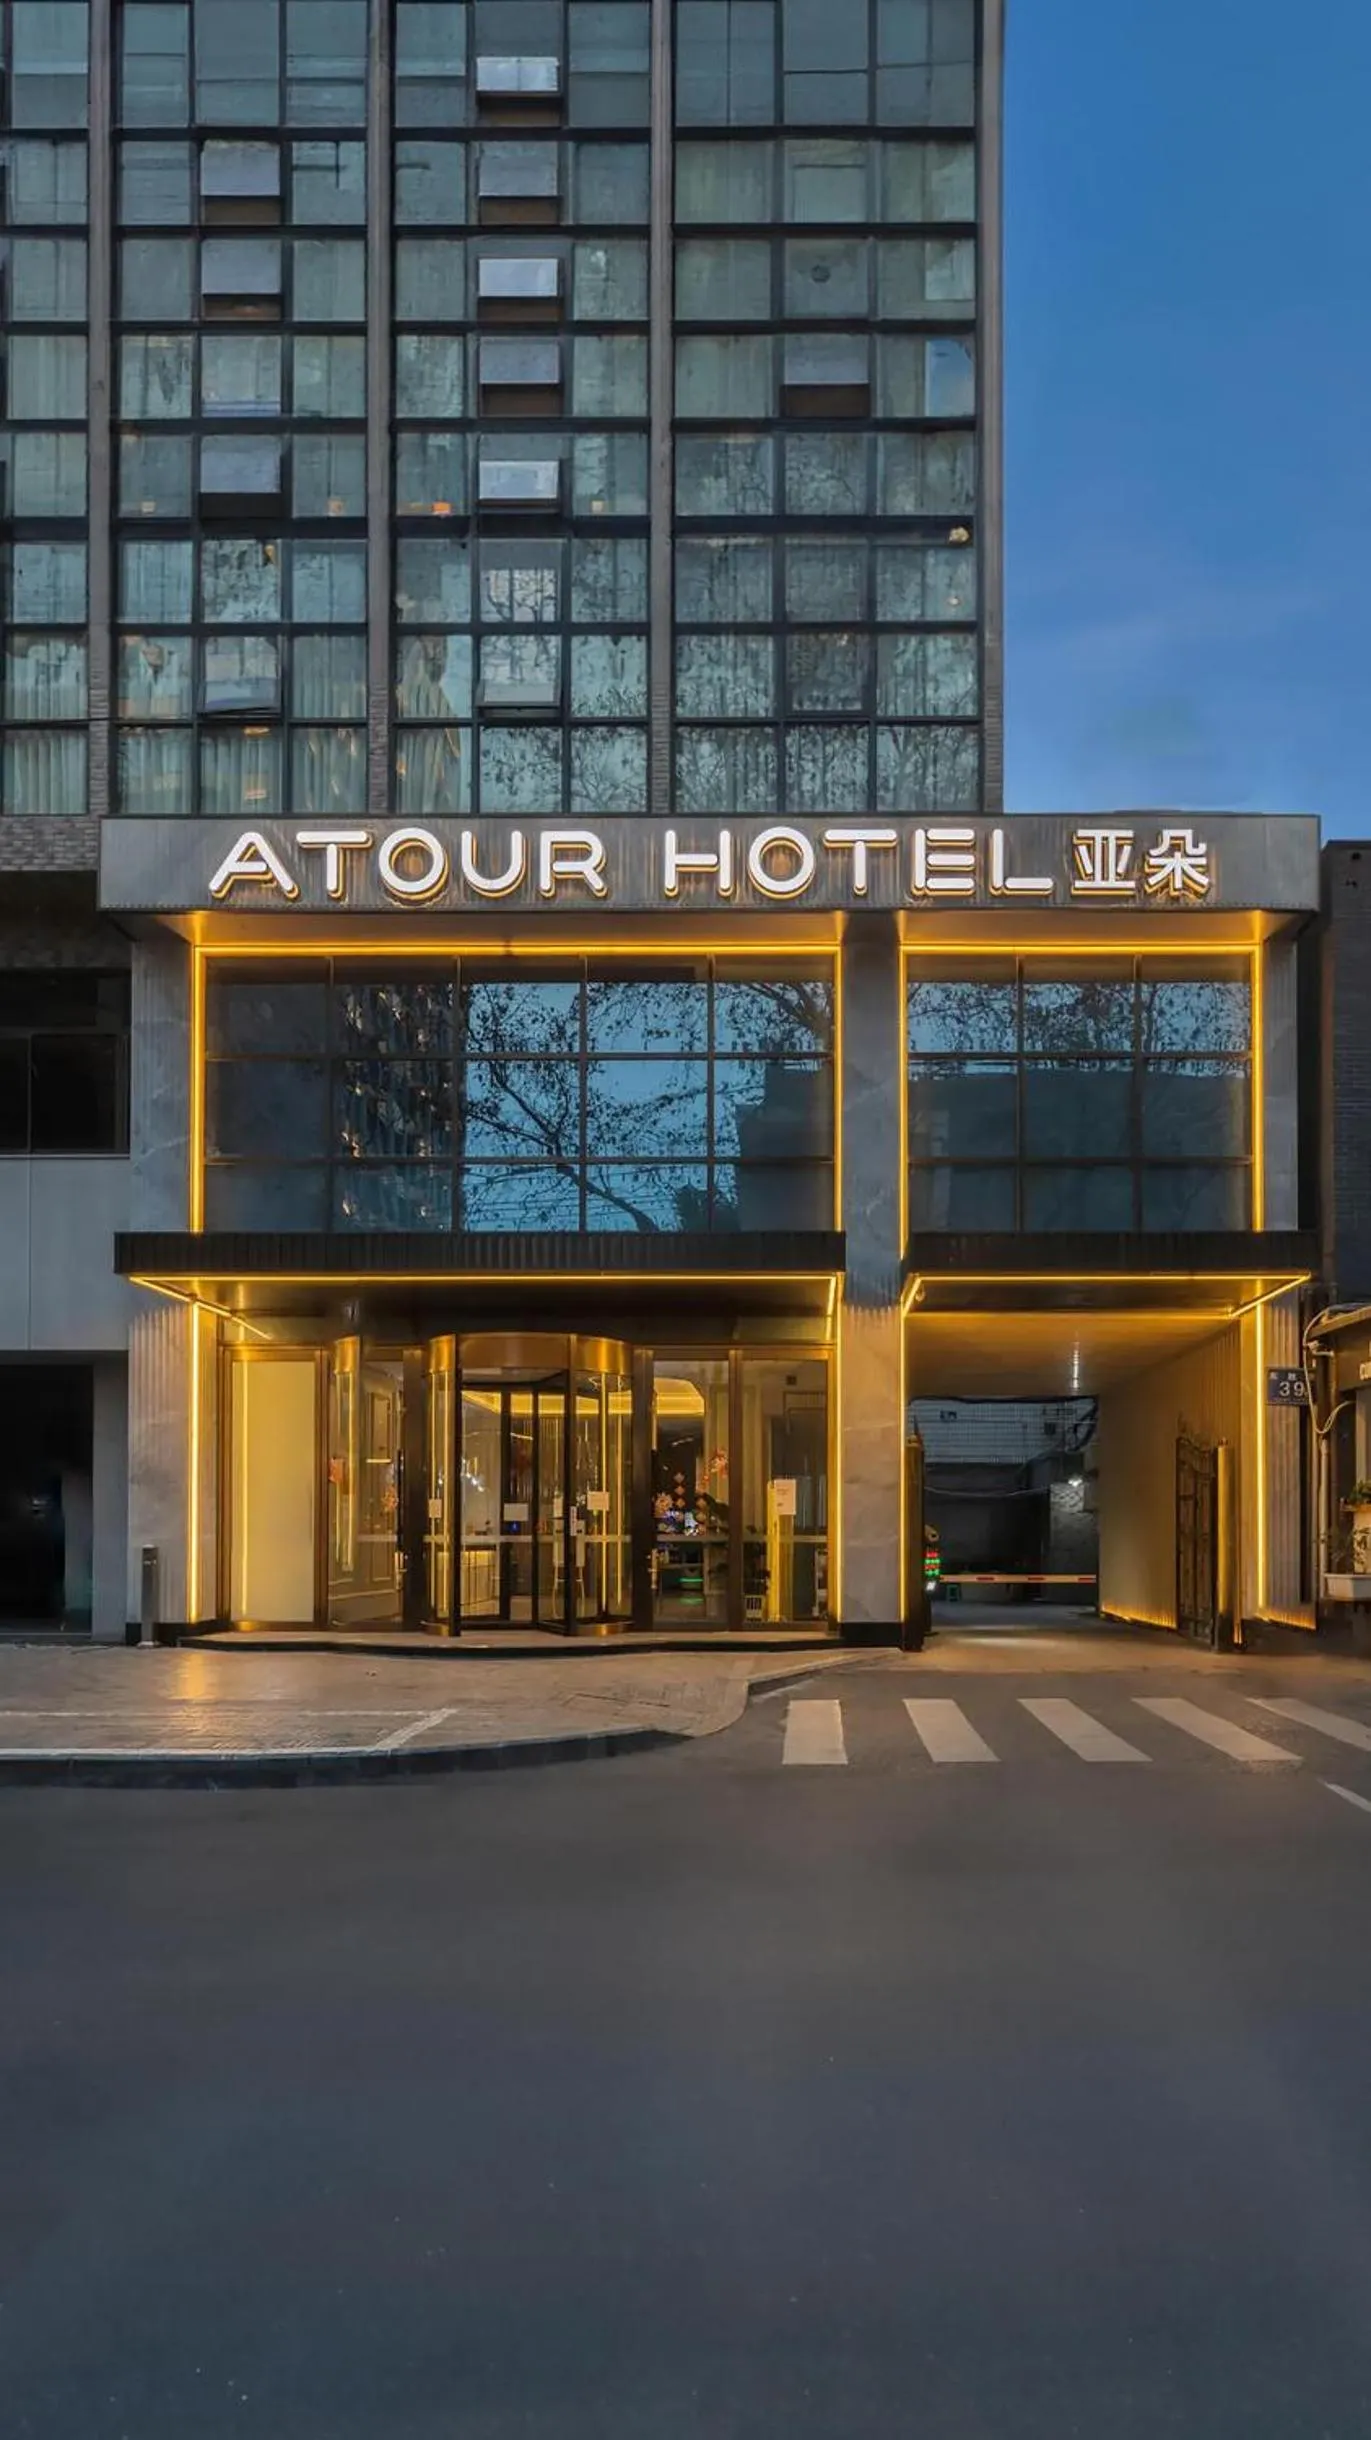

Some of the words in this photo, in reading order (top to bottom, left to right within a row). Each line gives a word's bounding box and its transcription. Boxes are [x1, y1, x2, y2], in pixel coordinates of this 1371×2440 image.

[208, 826, 608, 897] ATOUR
[663, 826, 1054, 898] HOTEL
[1071, 828, 1211, 894] 亚朵
